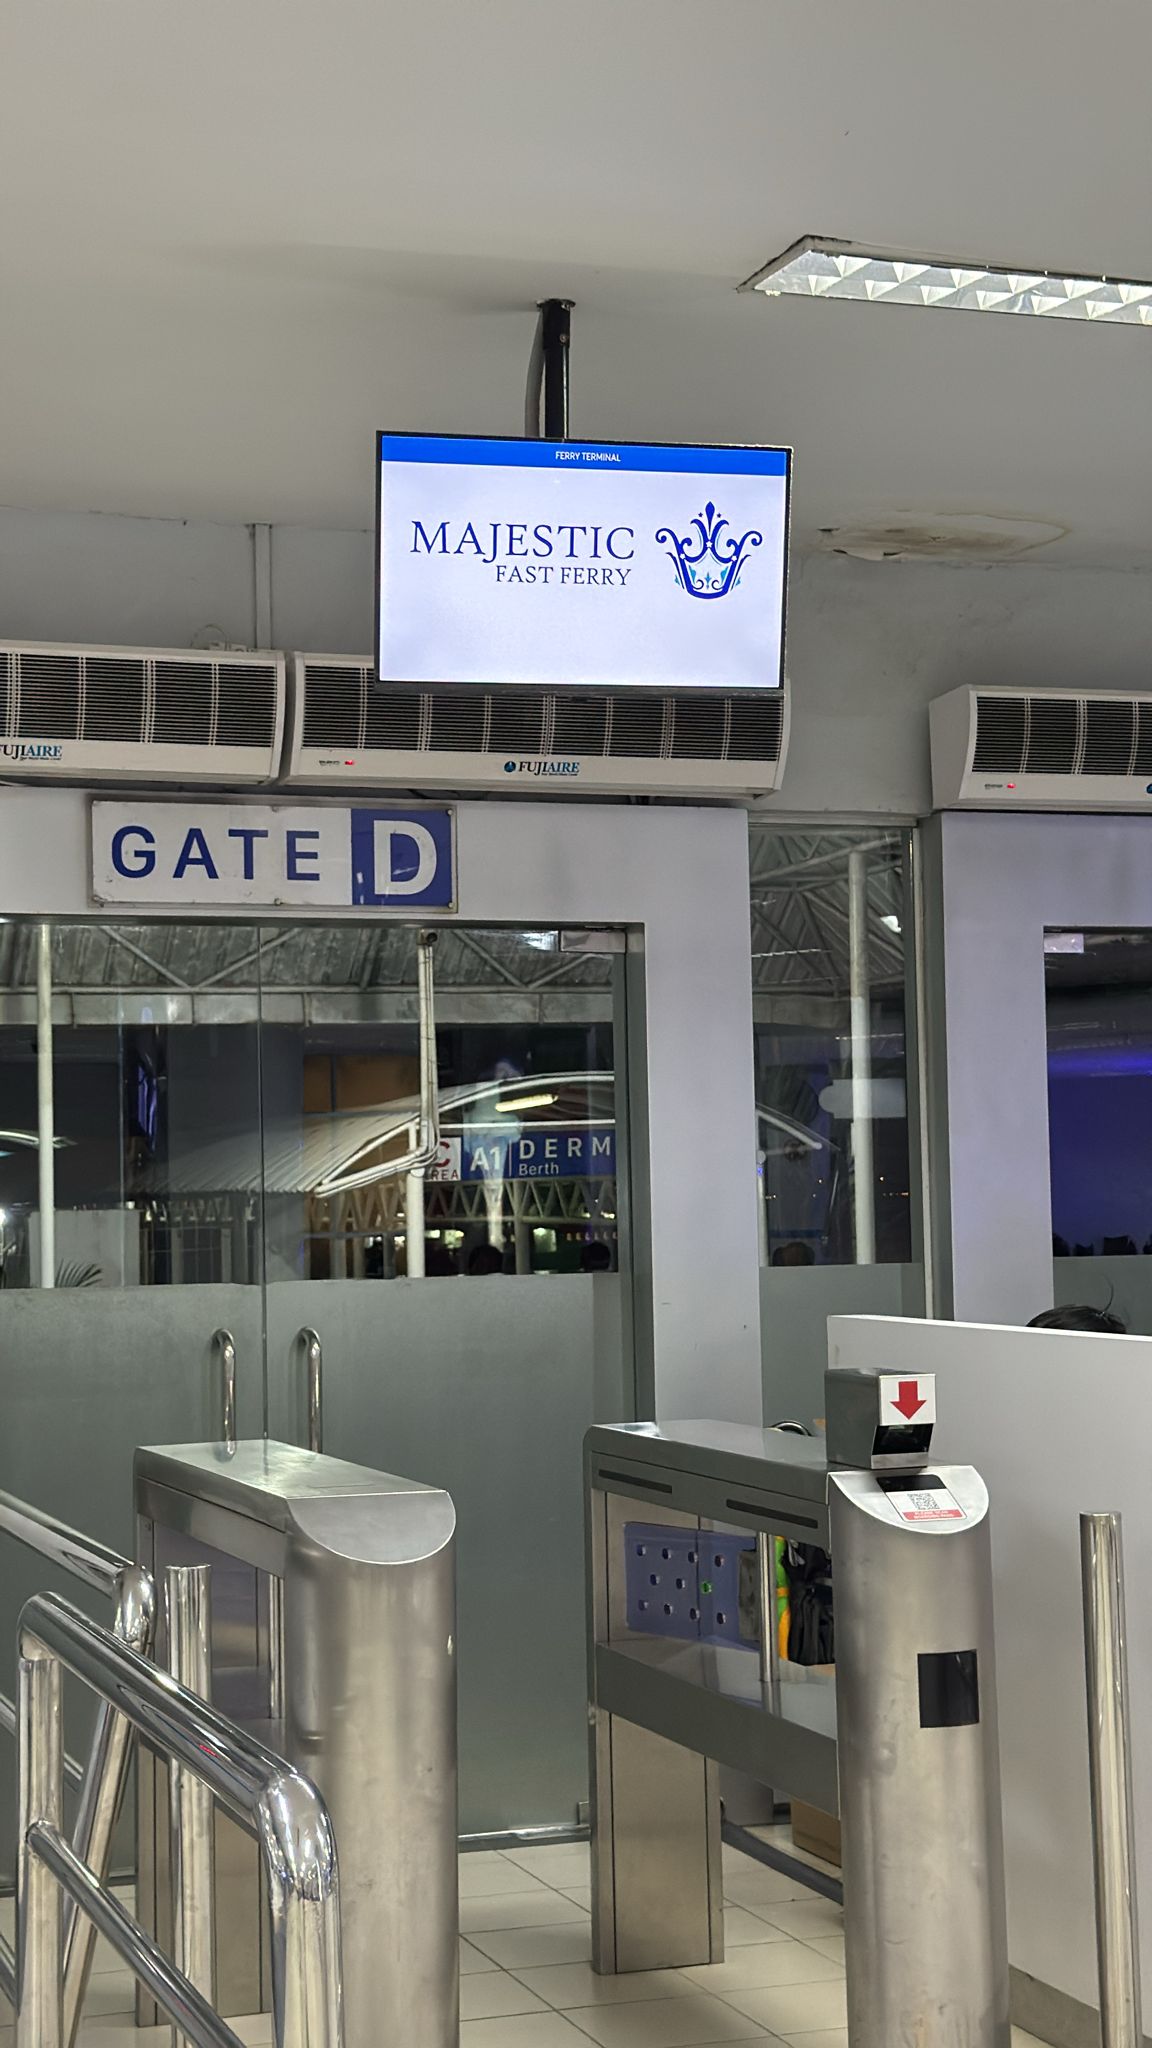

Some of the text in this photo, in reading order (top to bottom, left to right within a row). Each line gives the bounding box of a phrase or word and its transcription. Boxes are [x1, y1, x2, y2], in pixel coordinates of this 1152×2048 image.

[555, 451, 621, 462] FERRY TERMINAL
[410, 520, 635, 563] MAJESTIC
[496, 565, 632, 586] FAST FERRY
[519, 761, 580, 776] FUJIAIRE
[111, 819, 437, 895] GATE D
[470, 1146, 500, 1171] A1
[519, 1163, 559, 1176] Berth
